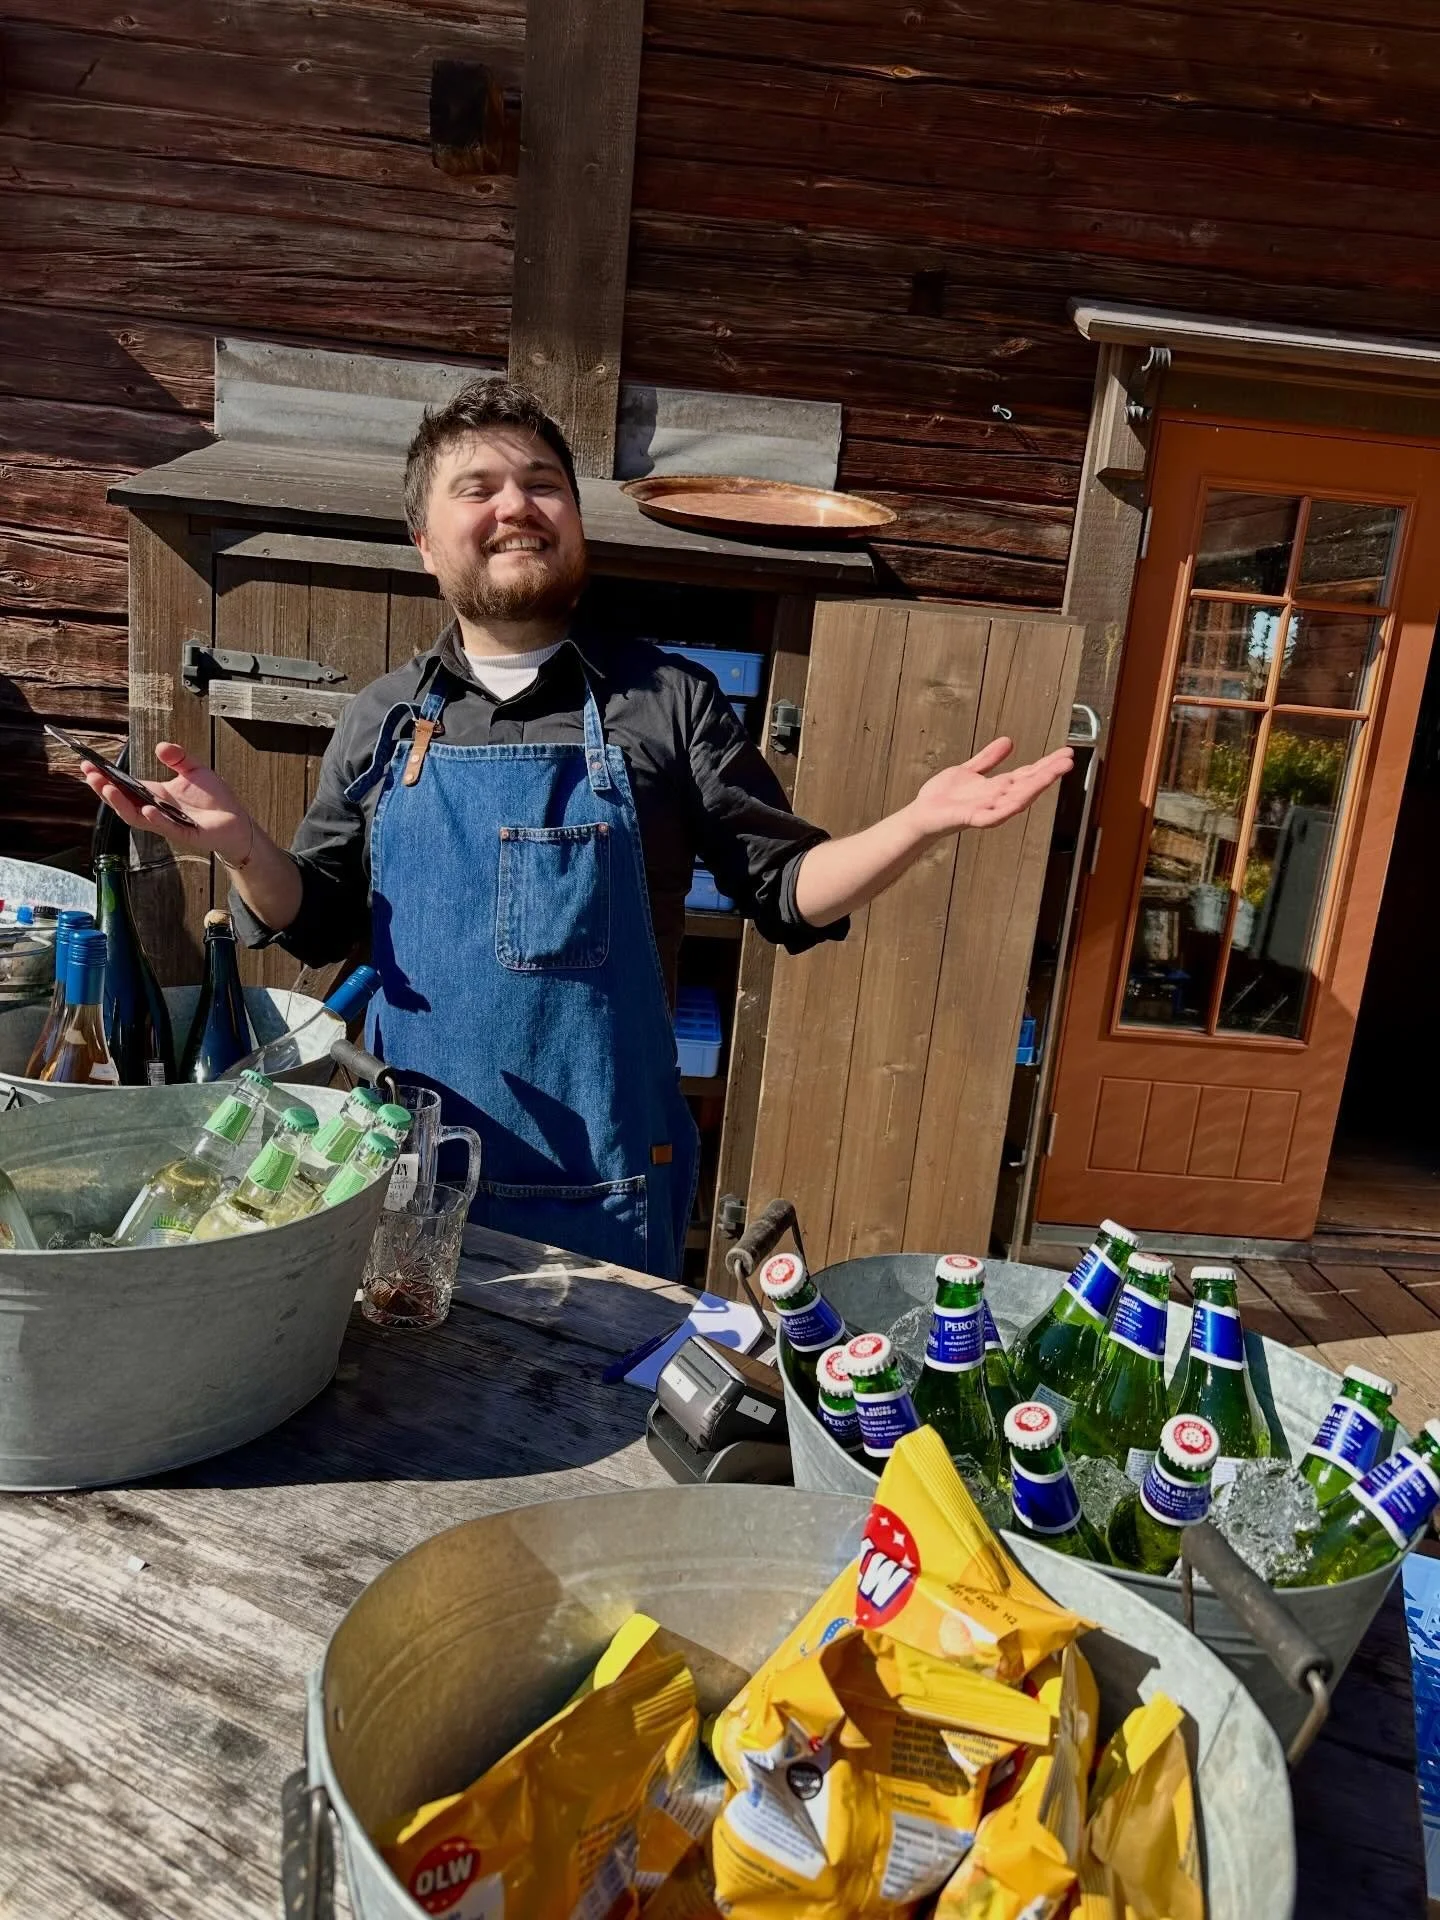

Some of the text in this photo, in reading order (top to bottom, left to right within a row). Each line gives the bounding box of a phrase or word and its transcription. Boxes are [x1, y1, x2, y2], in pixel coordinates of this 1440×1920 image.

[944, 1320, 980, 1332] PERON
[823, 1412, 858, 1427] PERON
[415, 1852, 473, 1897] OLW
